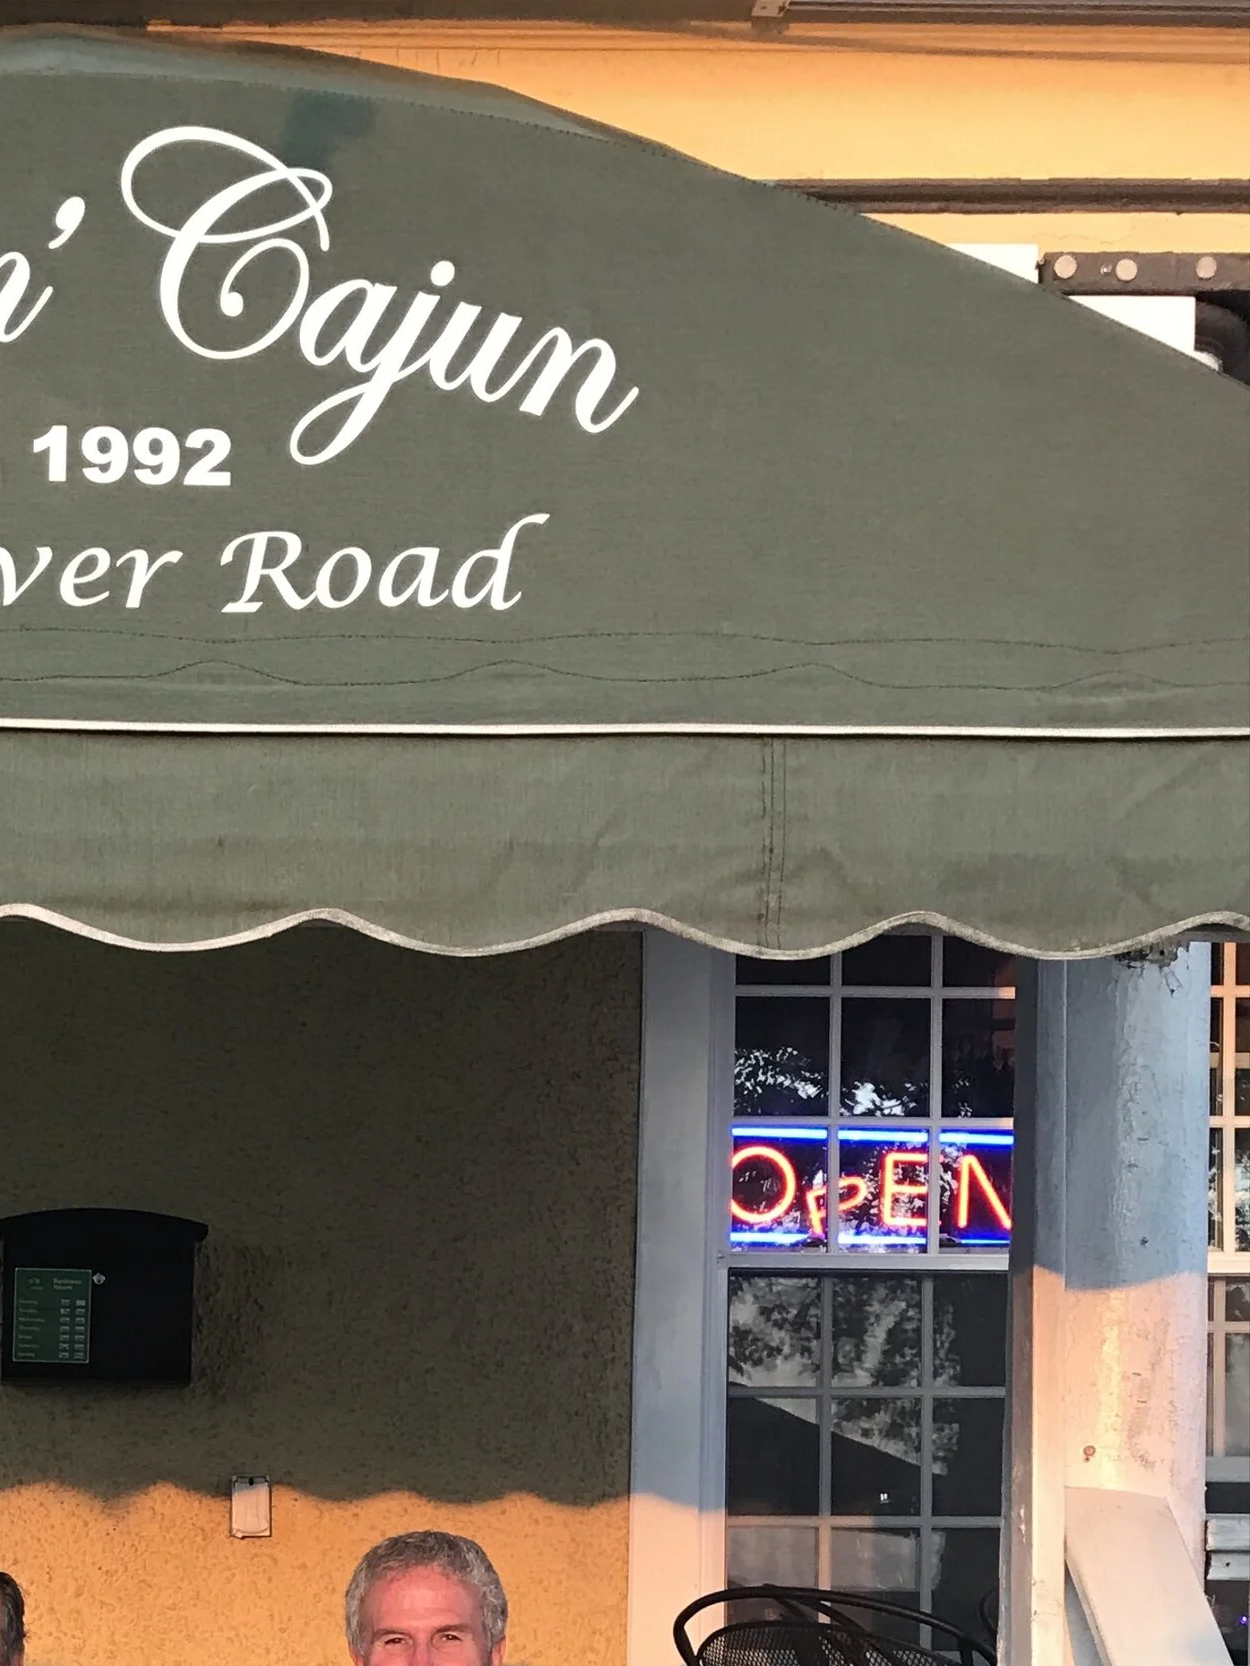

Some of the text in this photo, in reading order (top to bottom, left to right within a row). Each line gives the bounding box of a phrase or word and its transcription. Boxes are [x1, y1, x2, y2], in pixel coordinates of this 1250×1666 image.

[120, 125, 640, 466] Cajun
[33, 425, 232, 487] 1992
[220, 513, 551, 613] Road
